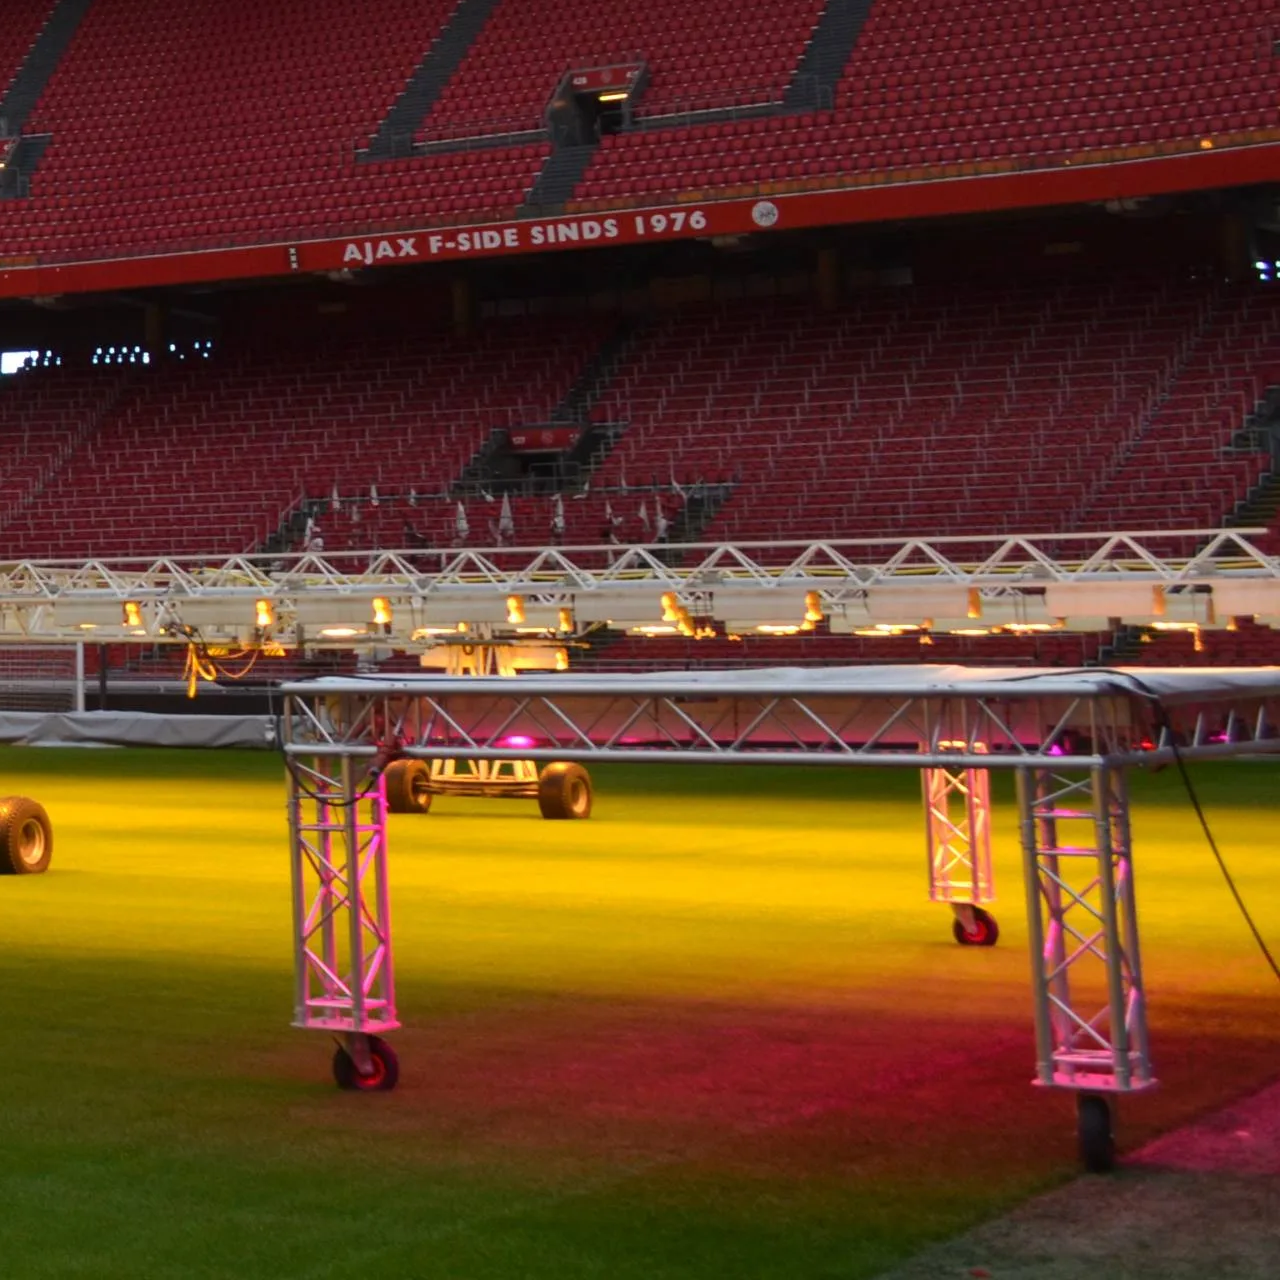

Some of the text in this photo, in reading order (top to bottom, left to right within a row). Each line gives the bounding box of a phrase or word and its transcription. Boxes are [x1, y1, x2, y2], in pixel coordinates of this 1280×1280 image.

[343, 210, 707, 265] AJAX F-SIDE SINDS 1976
